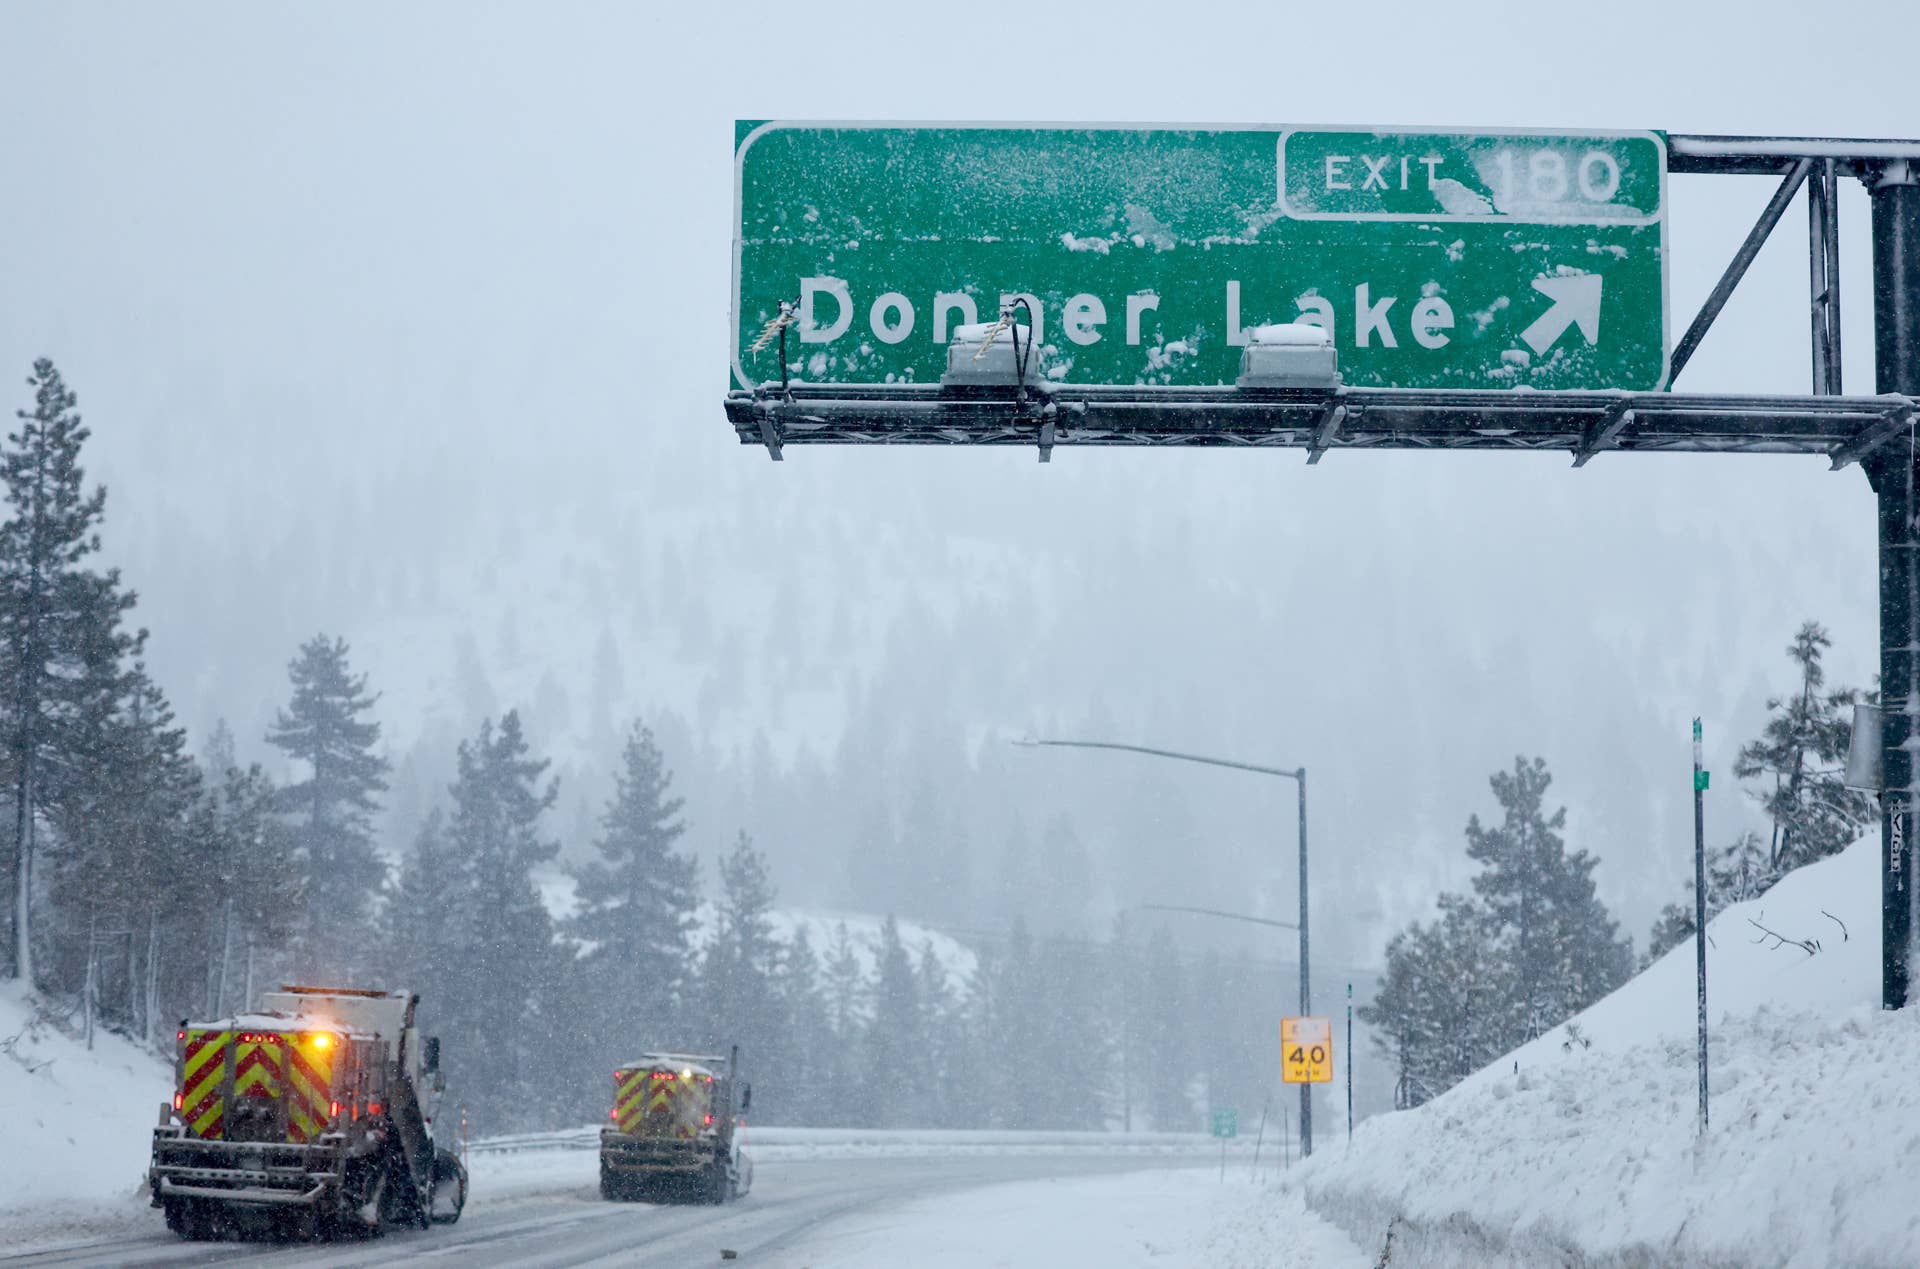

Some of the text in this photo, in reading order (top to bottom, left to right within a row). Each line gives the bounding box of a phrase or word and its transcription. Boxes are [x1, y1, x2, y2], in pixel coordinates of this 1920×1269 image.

[1326, 150, 1620, 202] EXIT 180
[800, 277, 1455, 349] Donner Lake
[1289, 1046, 1325, 1064] 40
